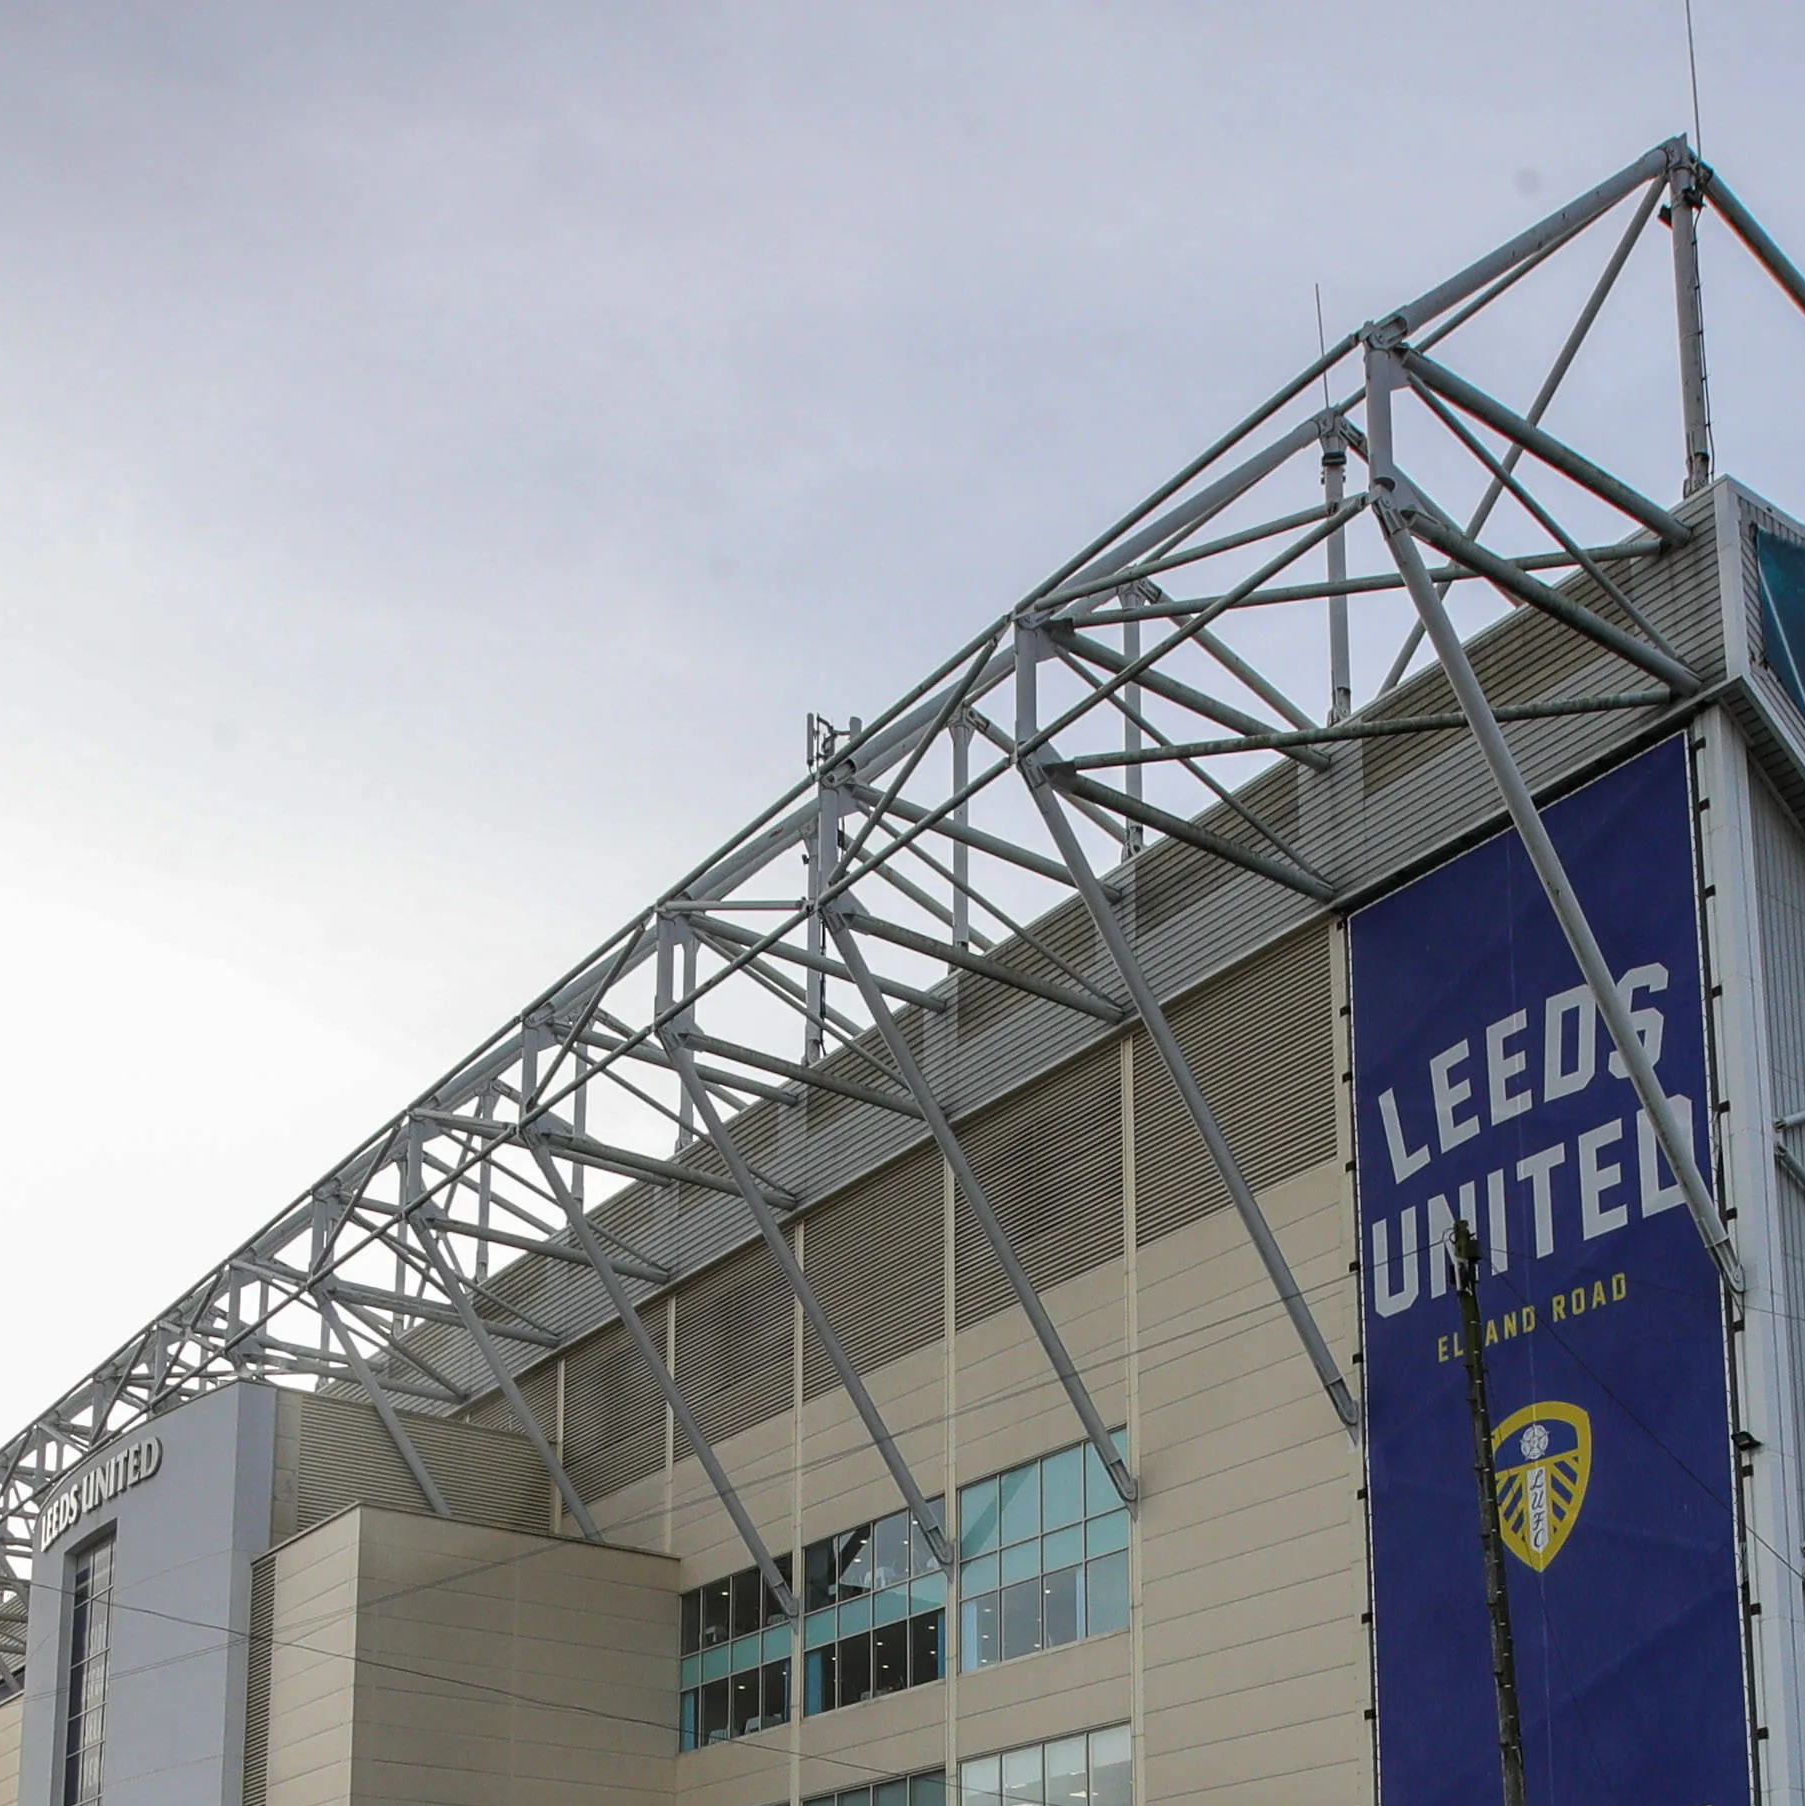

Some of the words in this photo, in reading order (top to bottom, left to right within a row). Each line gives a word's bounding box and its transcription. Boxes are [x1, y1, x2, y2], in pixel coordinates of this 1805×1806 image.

[1378, 962, 1669, 1184] LEEDS
[1372, 1094, 1693, 1318] UNITED
[1438, 1305, 1537, 1363] ELAND
[1552, 1272, 1626, 1323] ROAD
[41, 1484, 79, 1553] LEEDS
[81, 1436, 163, 1514] UNITED
